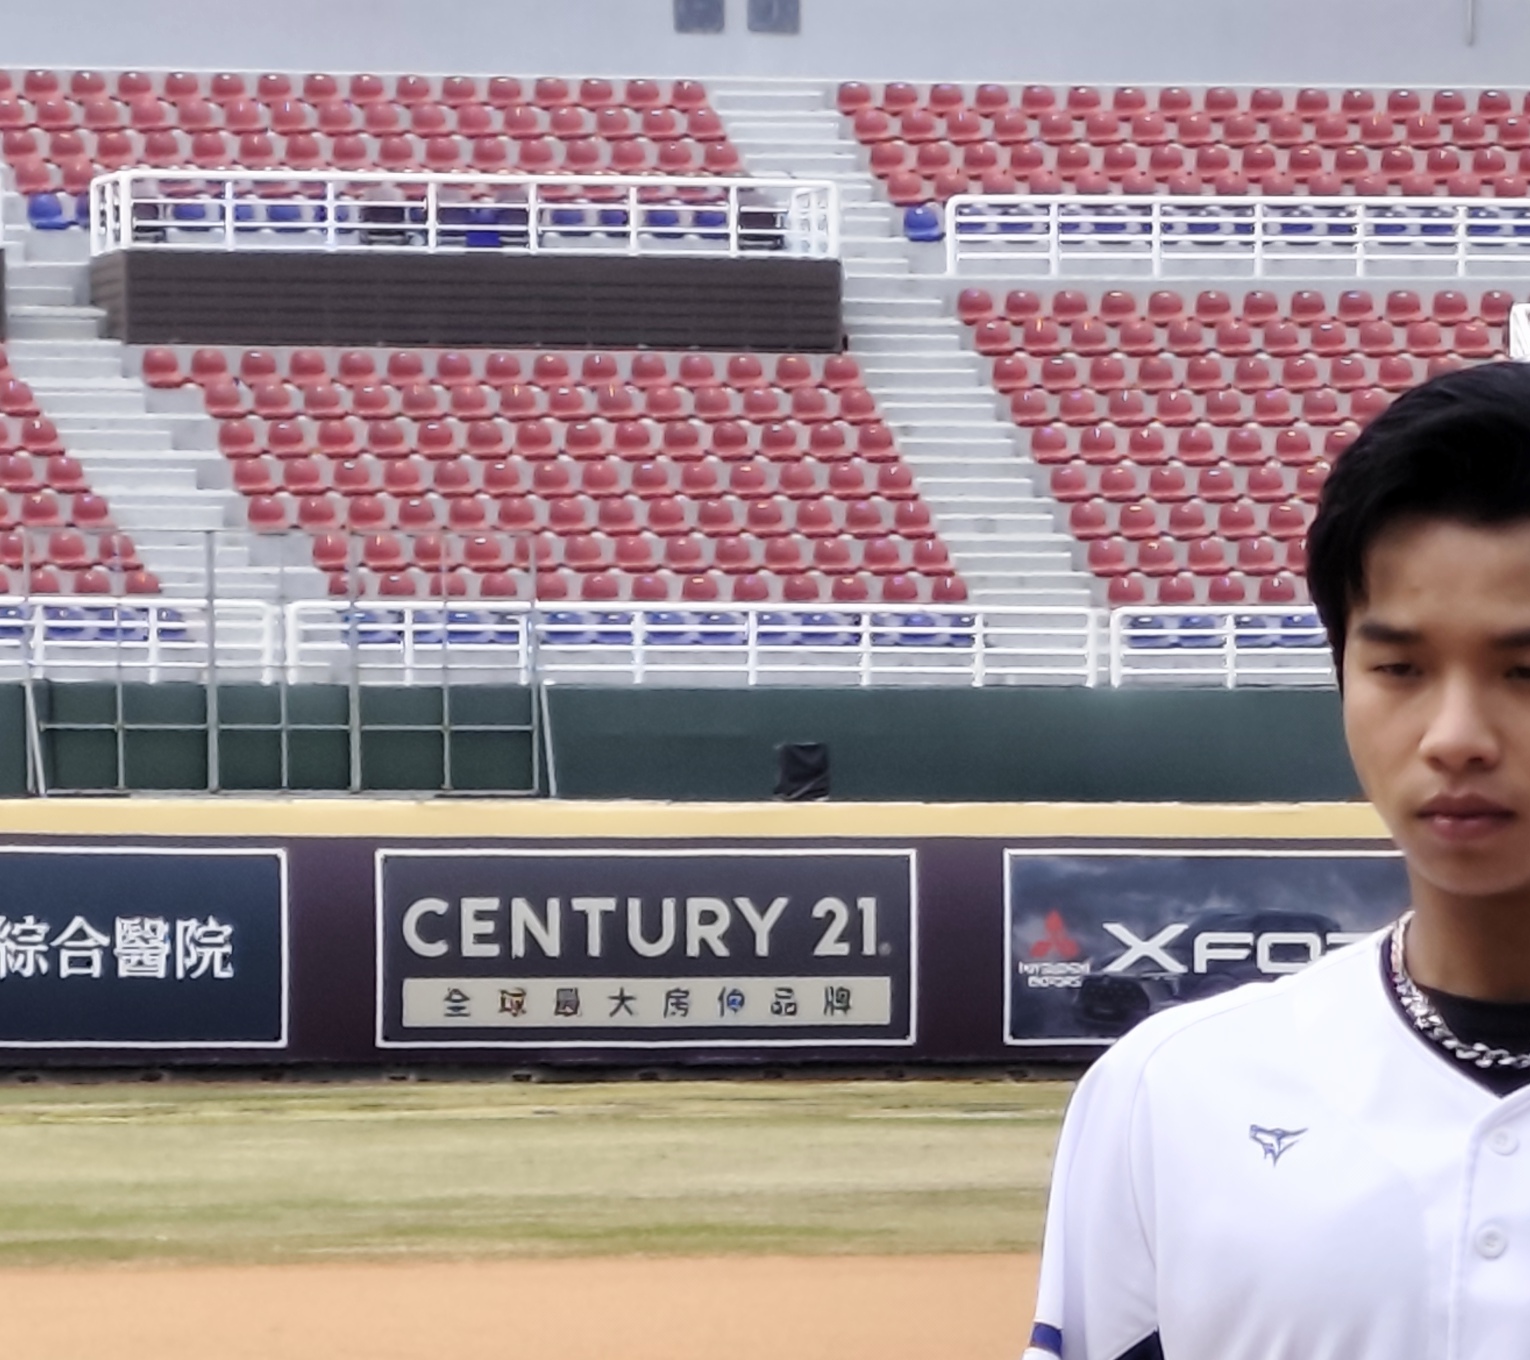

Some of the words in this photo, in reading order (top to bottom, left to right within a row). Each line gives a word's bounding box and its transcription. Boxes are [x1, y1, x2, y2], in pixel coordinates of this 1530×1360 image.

[0, 914, 234, 980] 綜合醫院
[402, 897, 788, 958] CENTURY
[812, 897, 878, 957] 21
